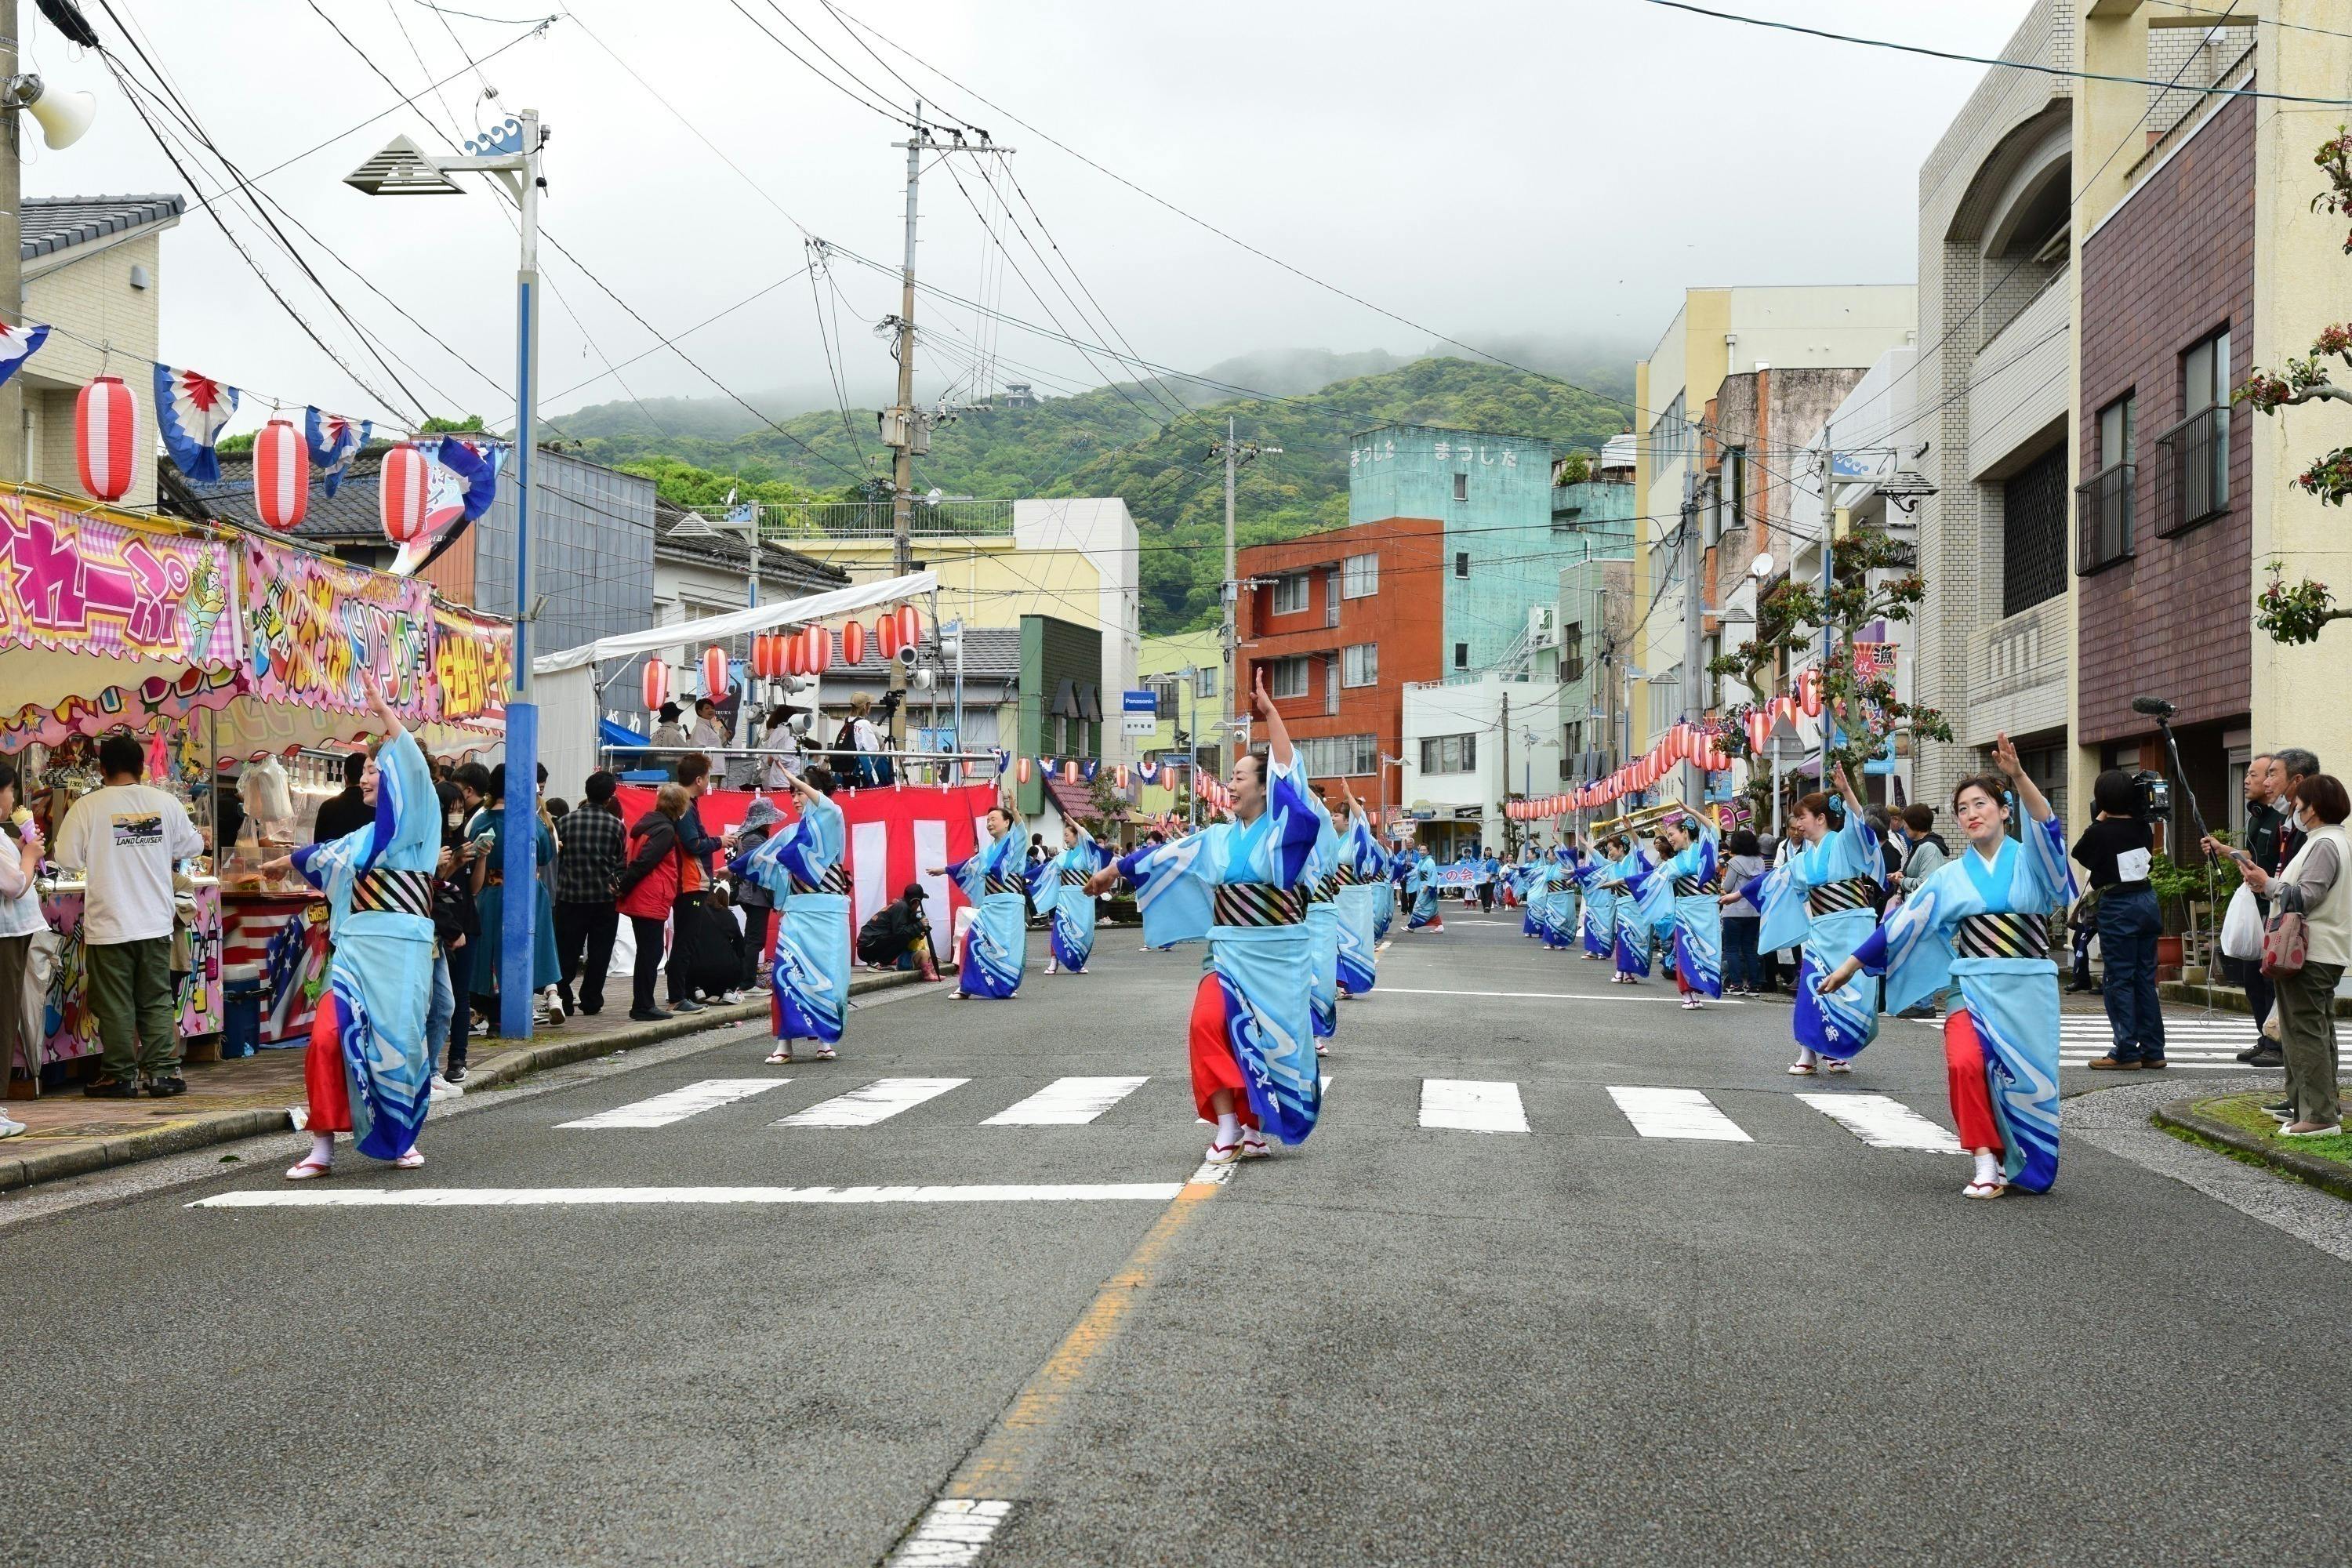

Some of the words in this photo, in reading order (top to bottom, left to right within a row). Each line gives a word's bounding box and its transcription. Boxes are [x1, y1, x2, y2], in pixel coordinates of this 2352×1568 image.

[1350, 439, 1395, 468] まつした
[1434, 441, 1517, 467] まつした
[1873, 645, 1895, 666] 漁
[1858, 661, 1871, 673] 祝
[117, 837, 136, 846] LAND
[136, 836, 162, 844] CRUISER
